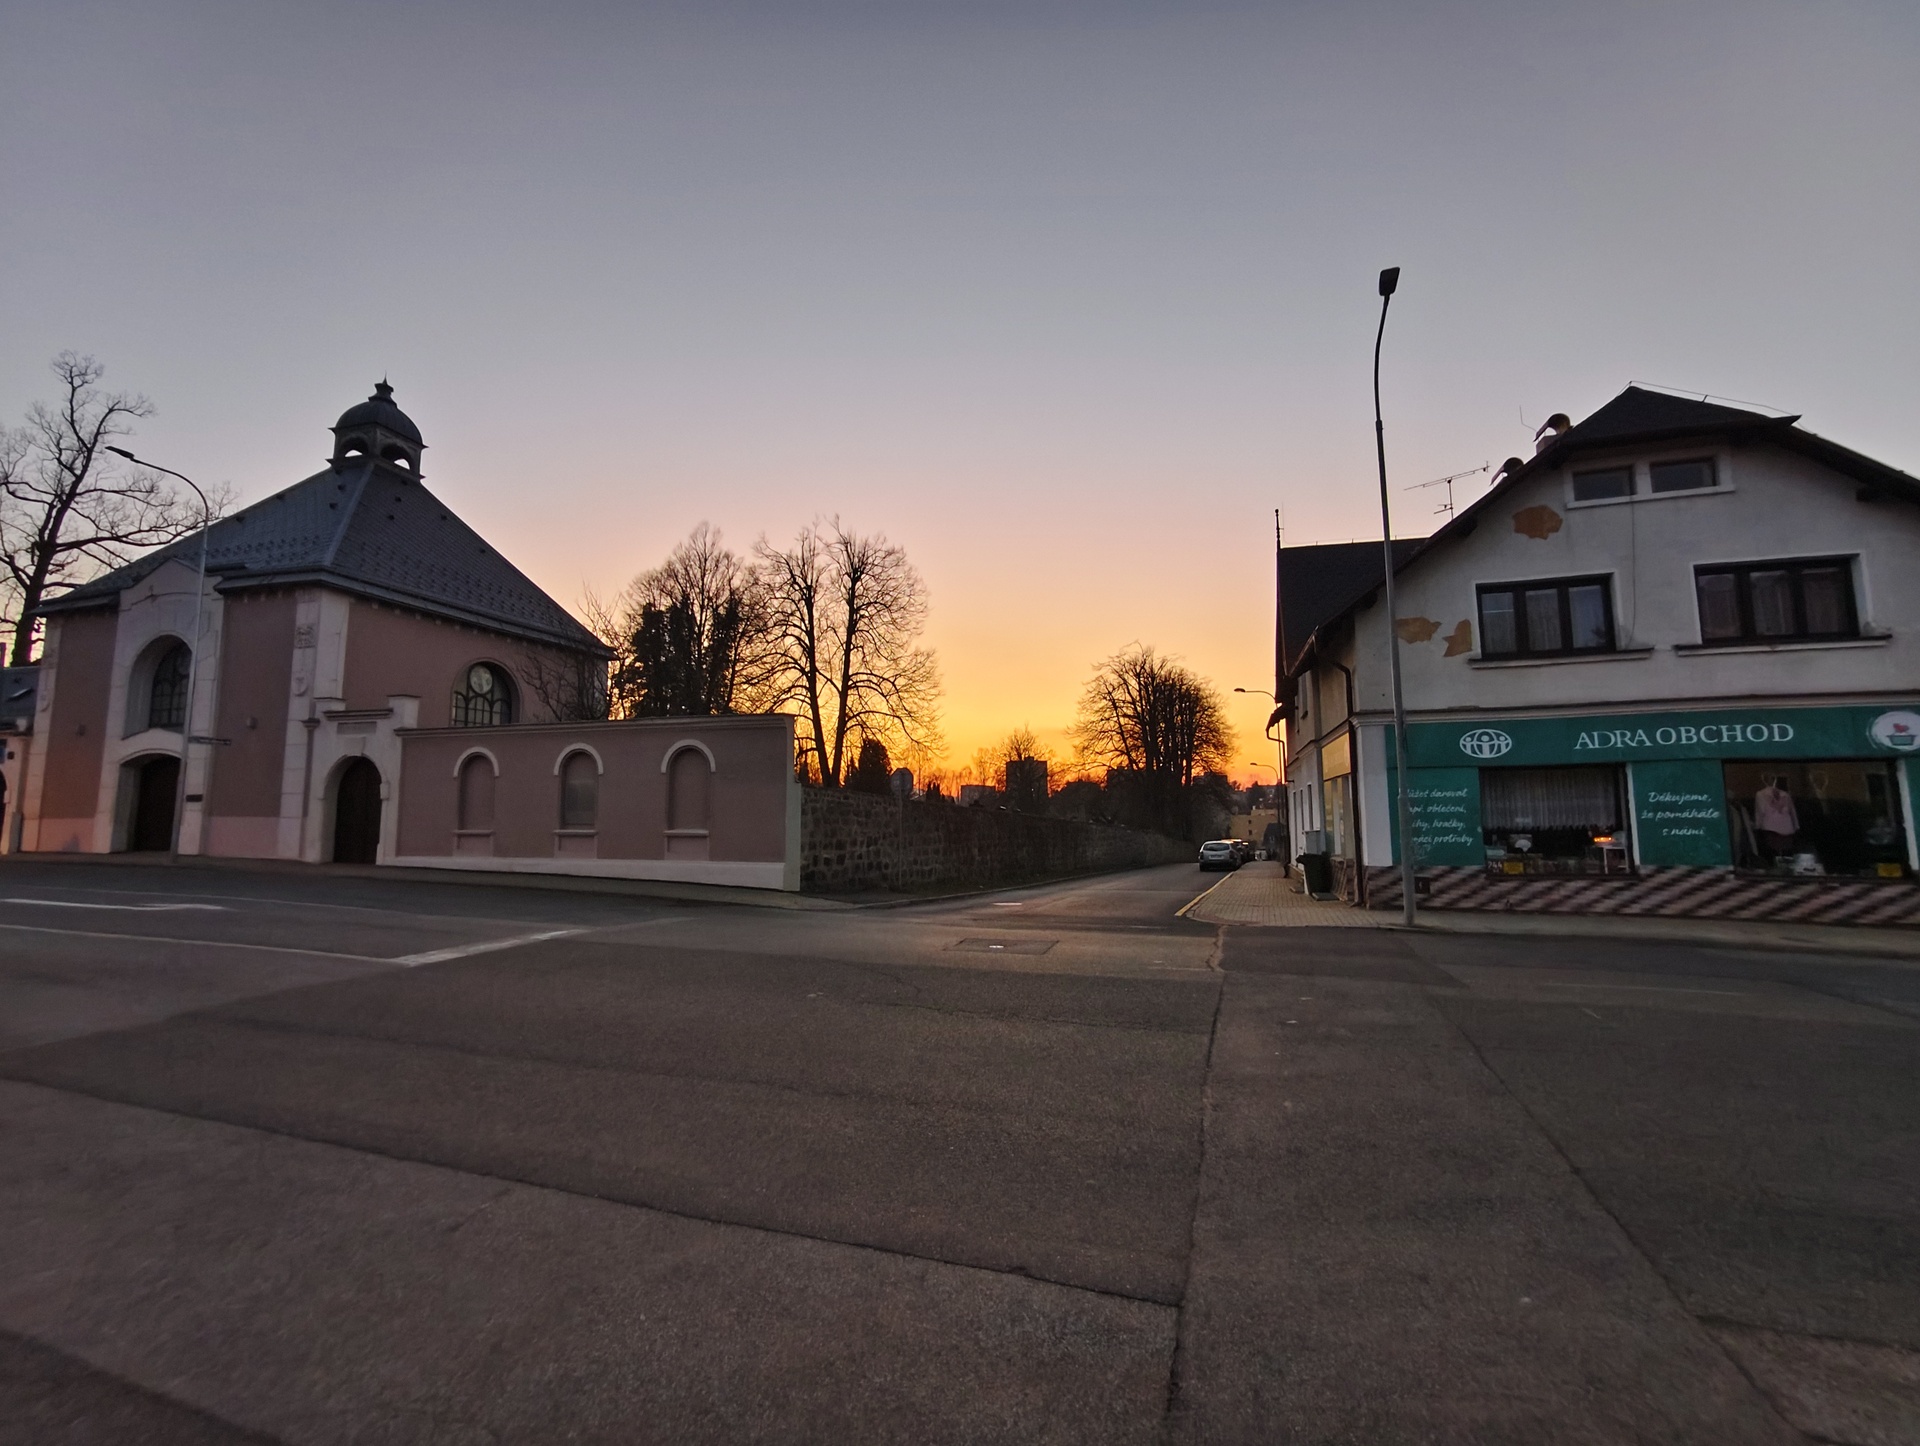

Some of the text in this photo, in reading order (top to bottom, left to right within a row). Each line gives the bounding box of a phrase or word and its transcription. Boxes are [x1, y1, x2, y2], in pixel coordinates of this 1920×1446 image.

[1573, 723, 1794, 750] ADRA OBCHOD
[1407, 788, 1468, 798] ůžeš darovat
[1648, 791, 1712, 805] Děkujeme,
[1426, 803, 1467, 814] oblečení,
[1655, 808, 1720, 822] pomáháte
[1432, 818, 1467, 831] hračky,
[1670, 826, 1705, 836] námi
